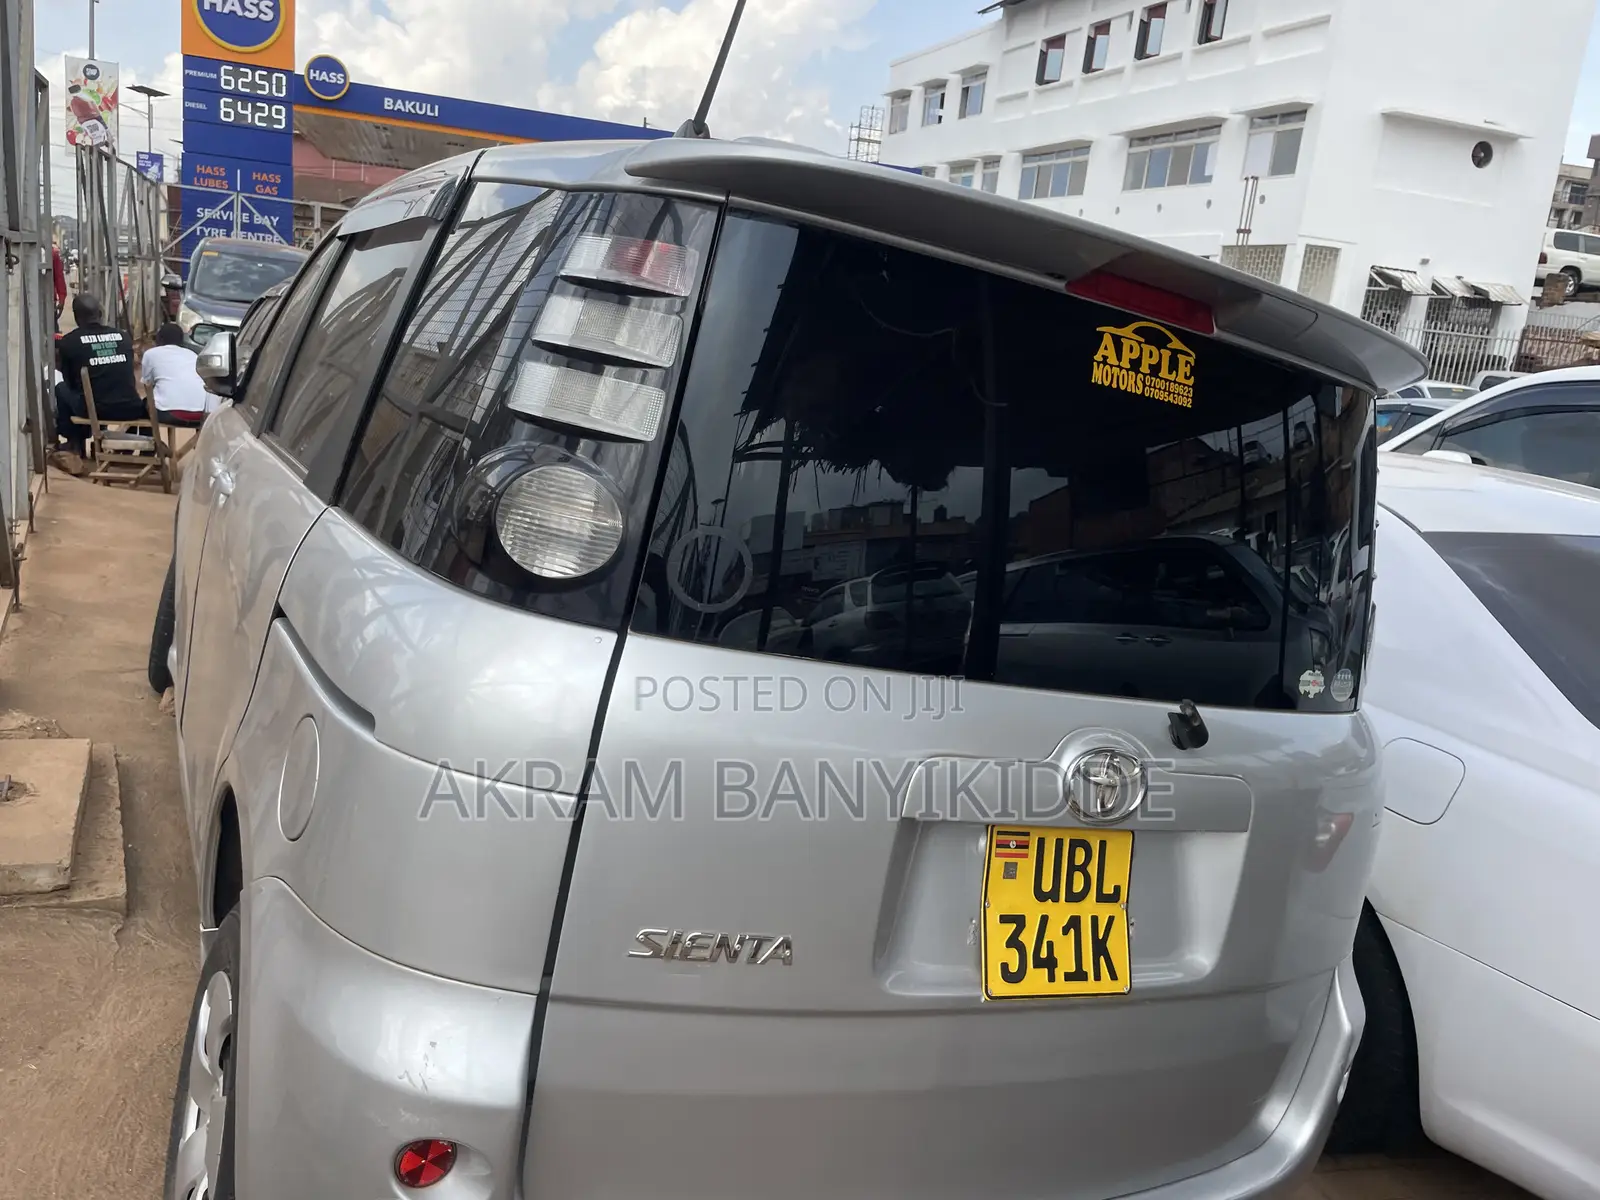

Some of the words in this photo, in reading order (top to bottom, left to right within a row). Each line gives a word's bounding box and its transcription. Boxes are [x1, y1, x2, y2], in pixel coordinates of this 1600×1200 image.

[203, 0, 275, 21] HASS
[184, 69, 217, 80] PREMIUM
[220, 65, 286, 97] 6250
[309, 69, 345, 85] HASS
[185, 101, 208, 110] DIESEL
[220, 97, 286, 129] 6429
[383, 97, 439, 117] BAKULI
[196, 164, 226, 177] HASS
[252, 172, 281, 184] HASS
[194, 177, 229, 190] LUBES
[255, 184, 279, 196] GAS
[196, 207, 250, 224] SERVIE
[254, 215, 280, 226] BAY
[1093, 332, 1195, 386] APPLE
[1091, 361, 1144, 395] MOTORS
[1145, 375, 1193, 397] 0700189623
[1144, 386, 1193, 408] 0709543092
[1033, 836, 1122, 904] UBL
[627, 927, 794, 966] SIENTA
[998, 913, 1119, 985] 341K
